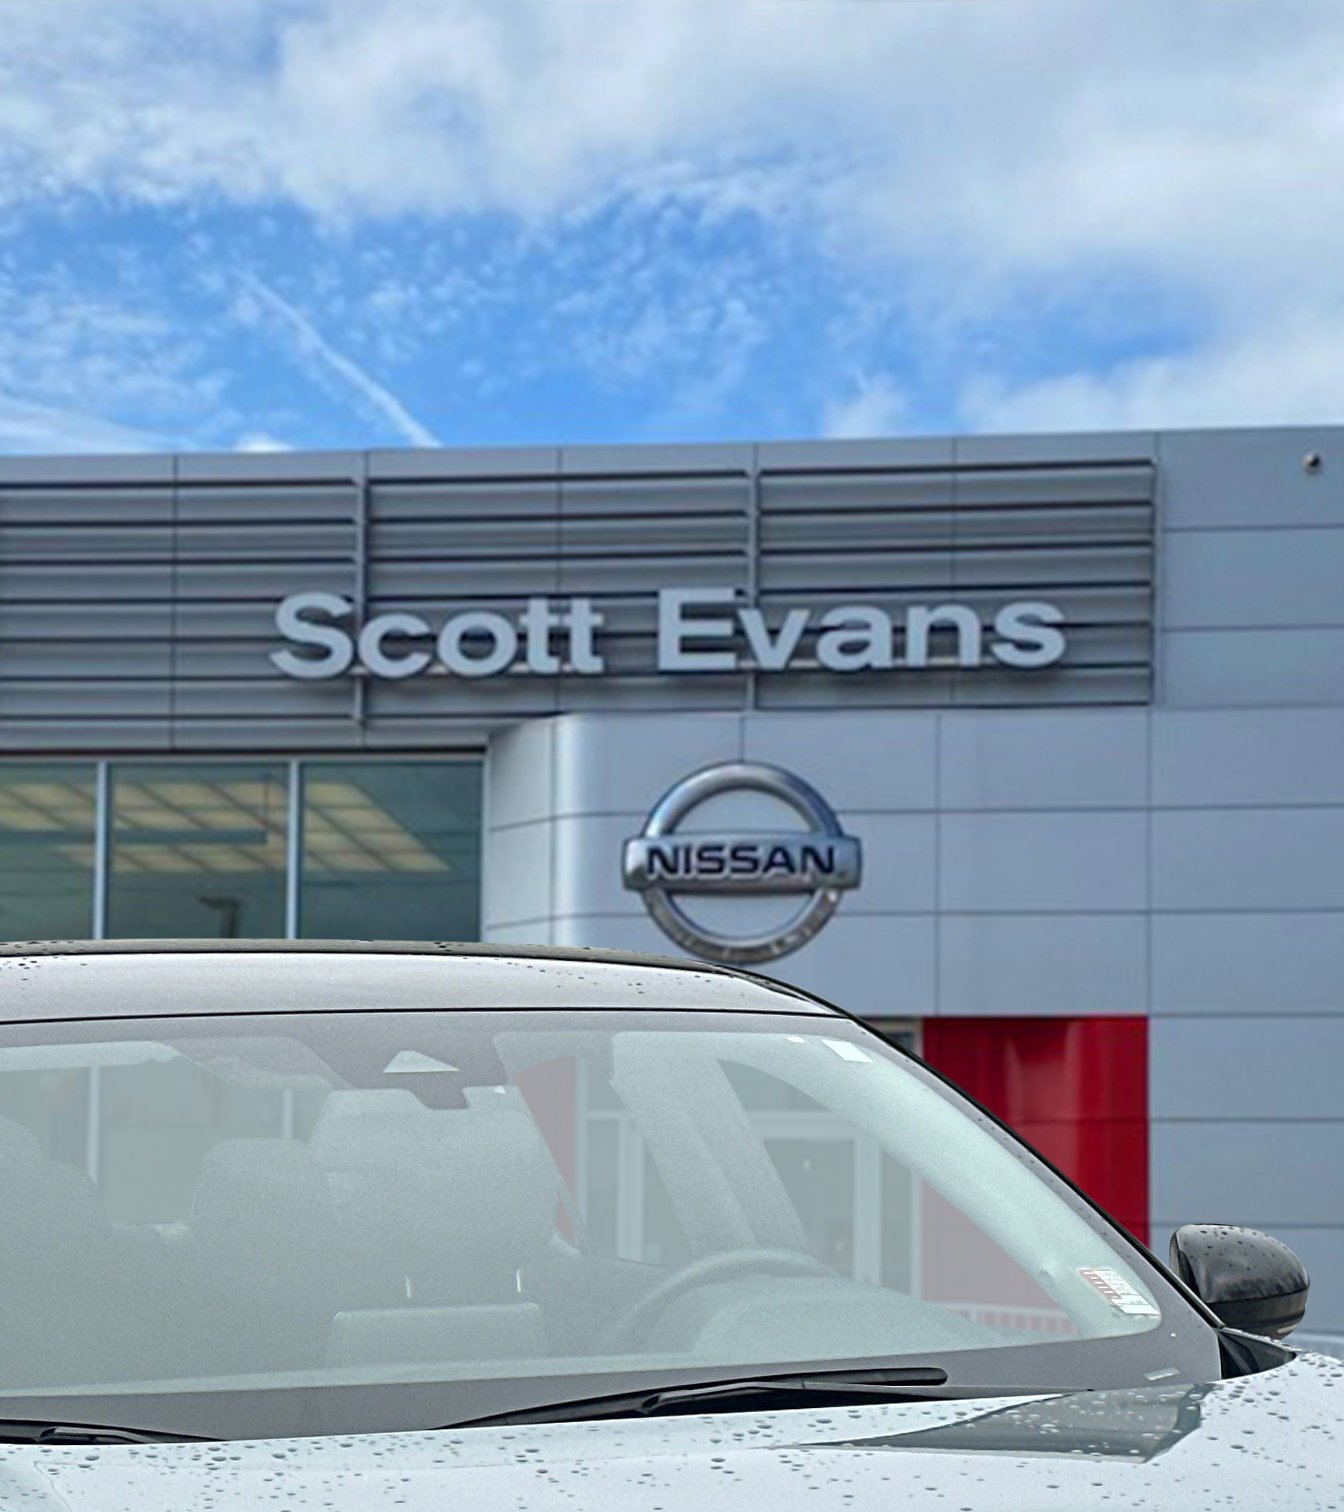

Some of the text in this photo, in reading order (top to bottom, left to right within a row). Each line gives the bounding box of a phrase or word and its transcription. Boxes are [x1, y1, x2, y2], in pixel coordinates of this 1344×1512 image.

[269, 588, 1067, 679] Scott Evans
[646, 845, 836, 880] NISSAN
